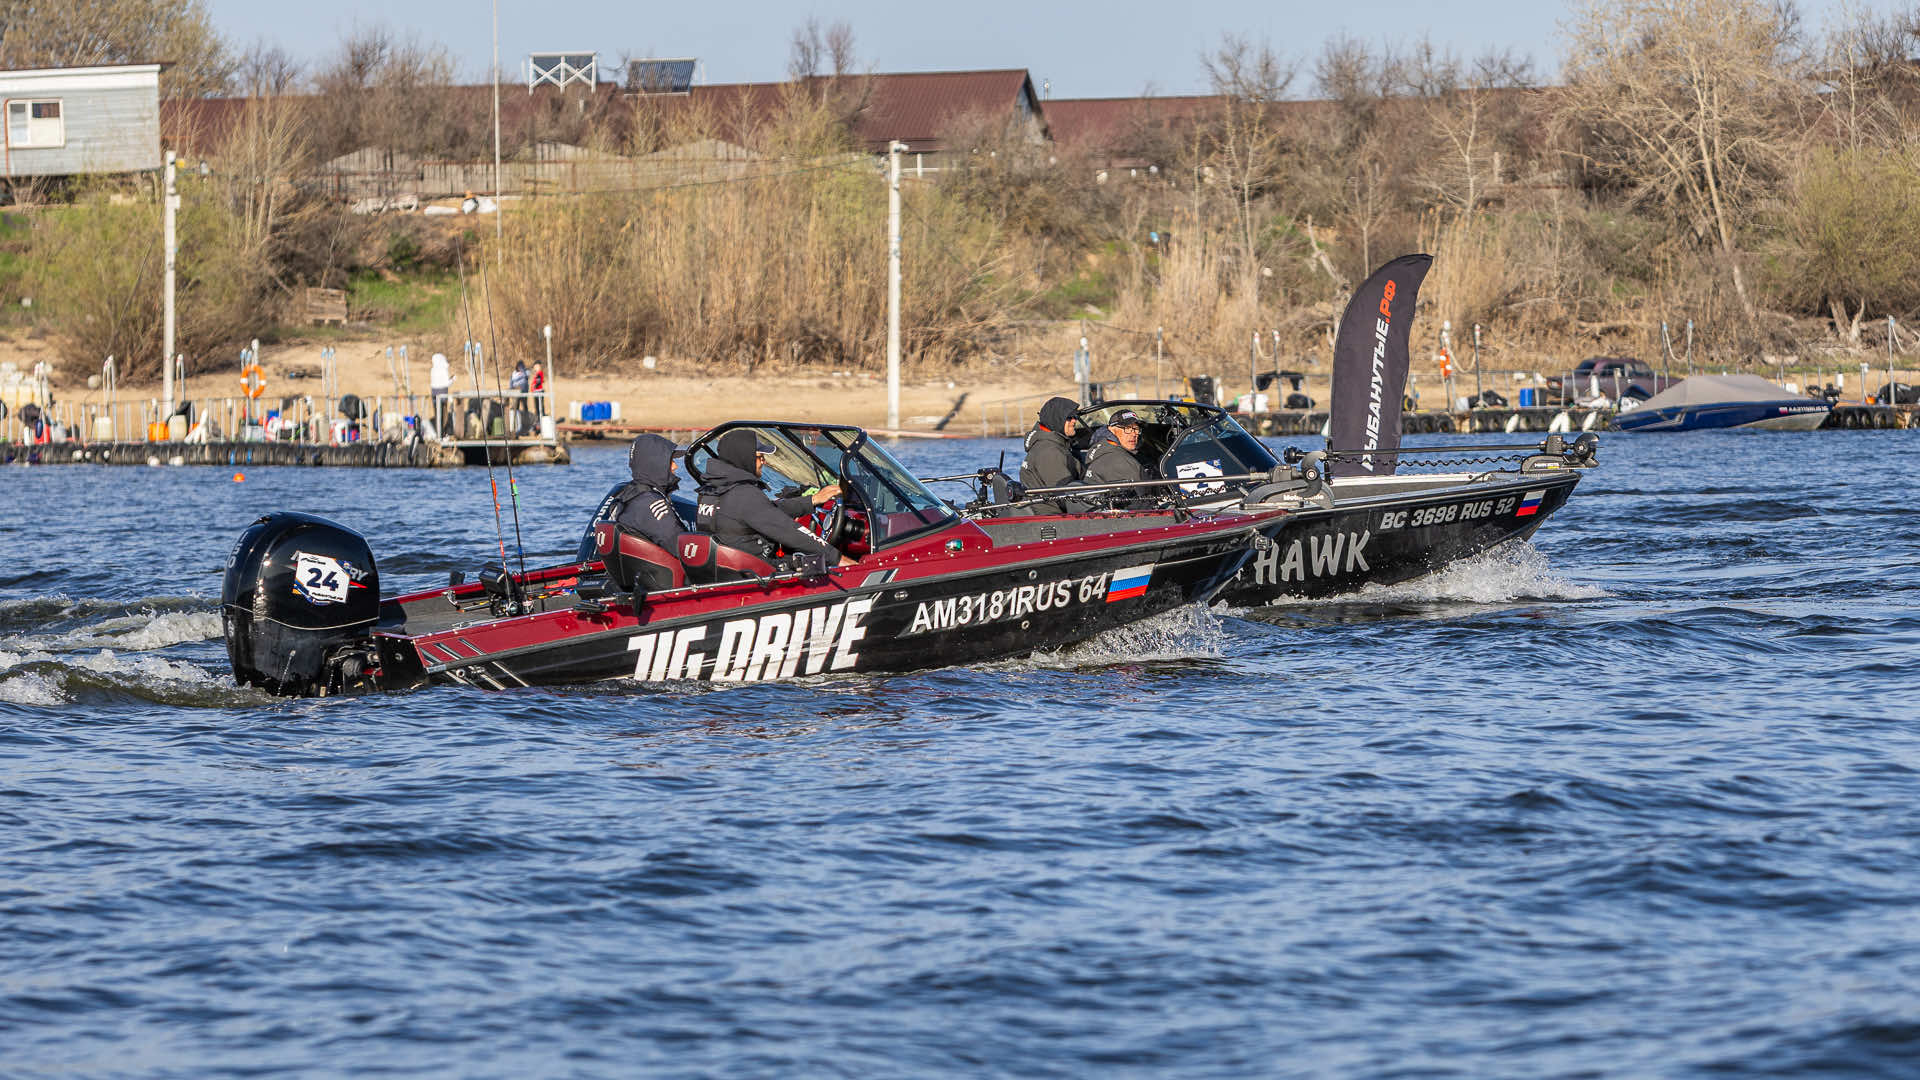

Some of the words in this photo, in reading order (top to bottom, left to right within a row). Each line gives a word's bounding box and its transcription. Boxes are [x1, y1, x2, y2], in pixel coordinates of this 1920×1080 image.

[1379, 510, 1407, 530] BC
[1410, 506, 1457, 527] 3698
[1459, 500, 1494, 520] RUS
[1495, 496, 1516, 515] 52
[1253, 529, 1371, 585] HAWK
[306, 567, 340, 592] 24
[1078, 572, 1108, 603] 64
[710, 598, 873, 682] DRIVE
